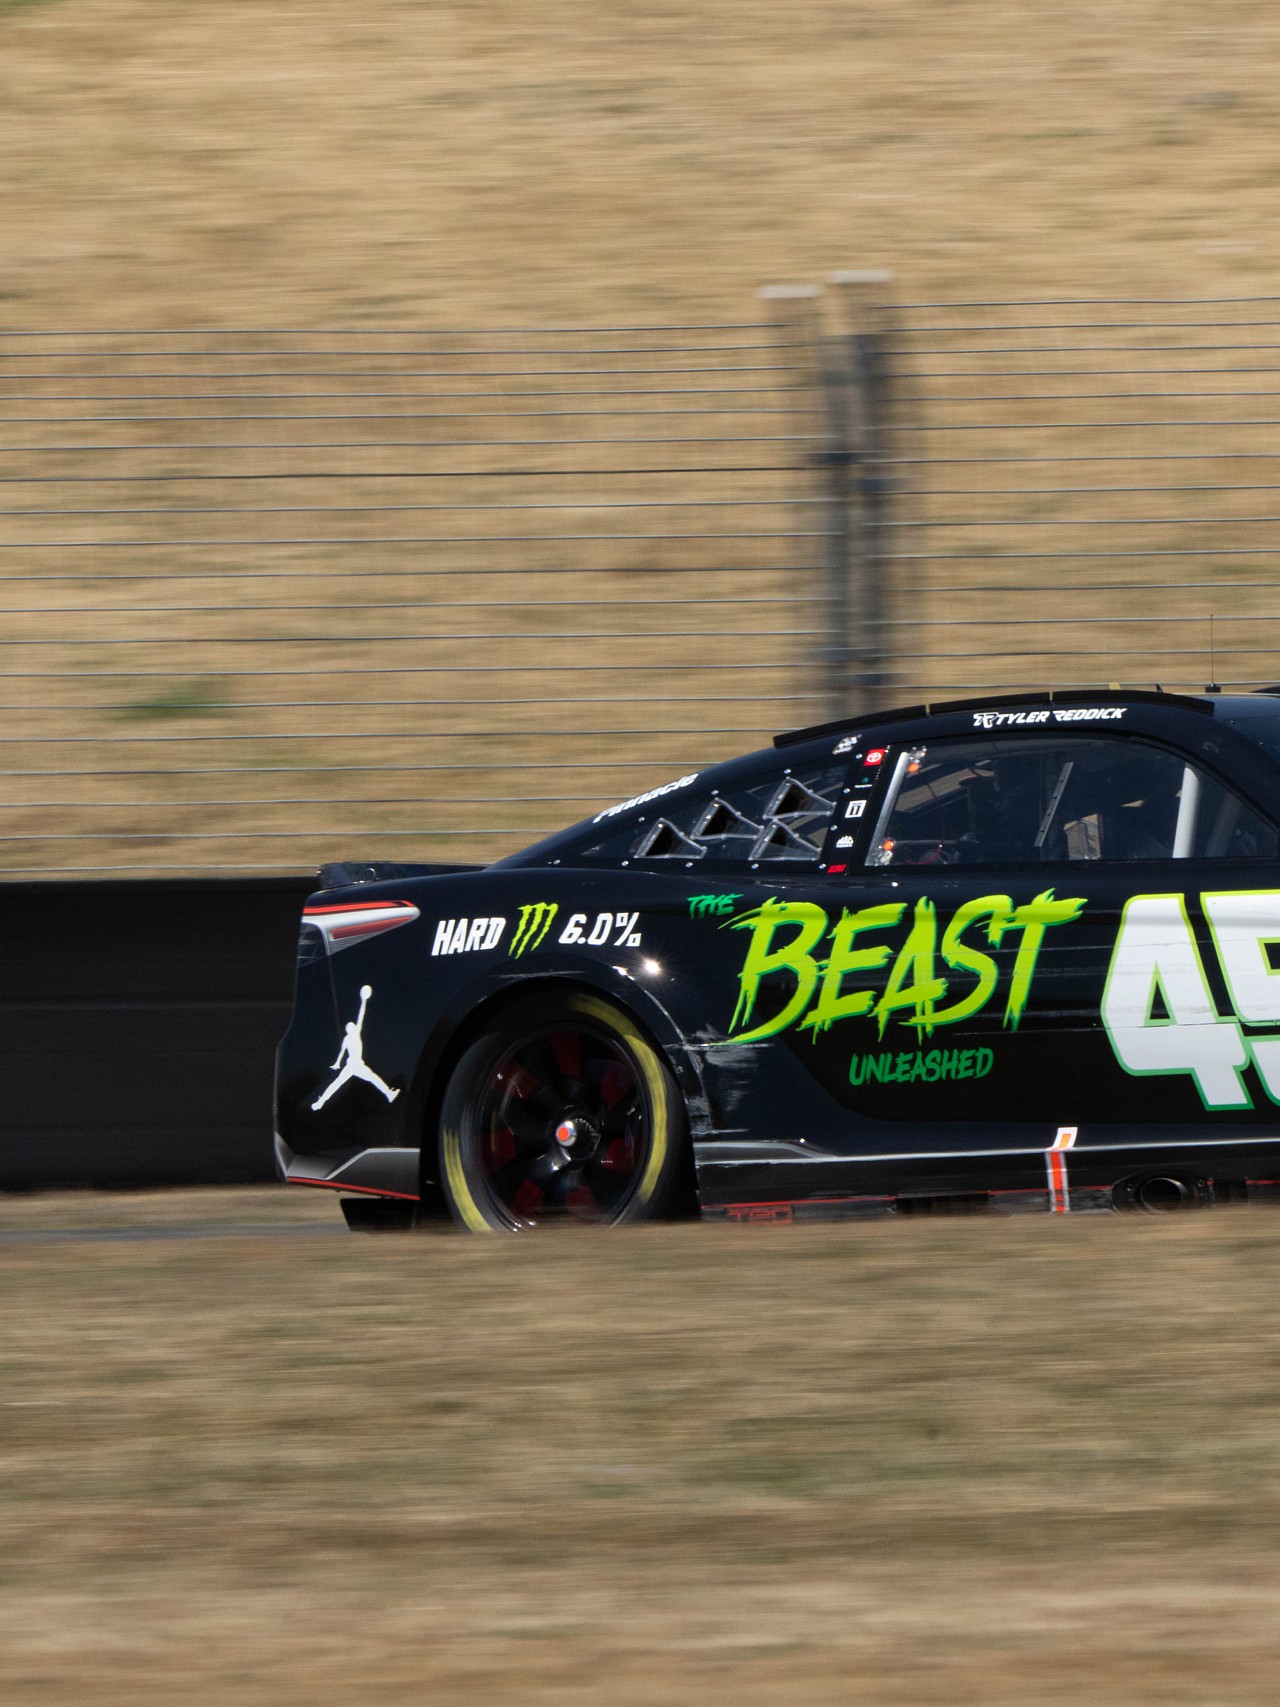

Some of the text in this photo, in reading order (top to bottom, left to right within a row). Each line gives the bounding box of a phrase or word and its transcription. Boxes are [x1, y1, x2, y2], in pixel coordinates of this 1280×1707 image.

[996, 710, 1050, 725] TYLER
[1053, 707, 1128, 721] REDDICK
[687, 894, 743, 920] THE
[431, 912, 642, 956] HARD 6.0%
[711, 888, 1088, 1046] BEAST
[849, 1047, 994, 1086] UNLEASHED
